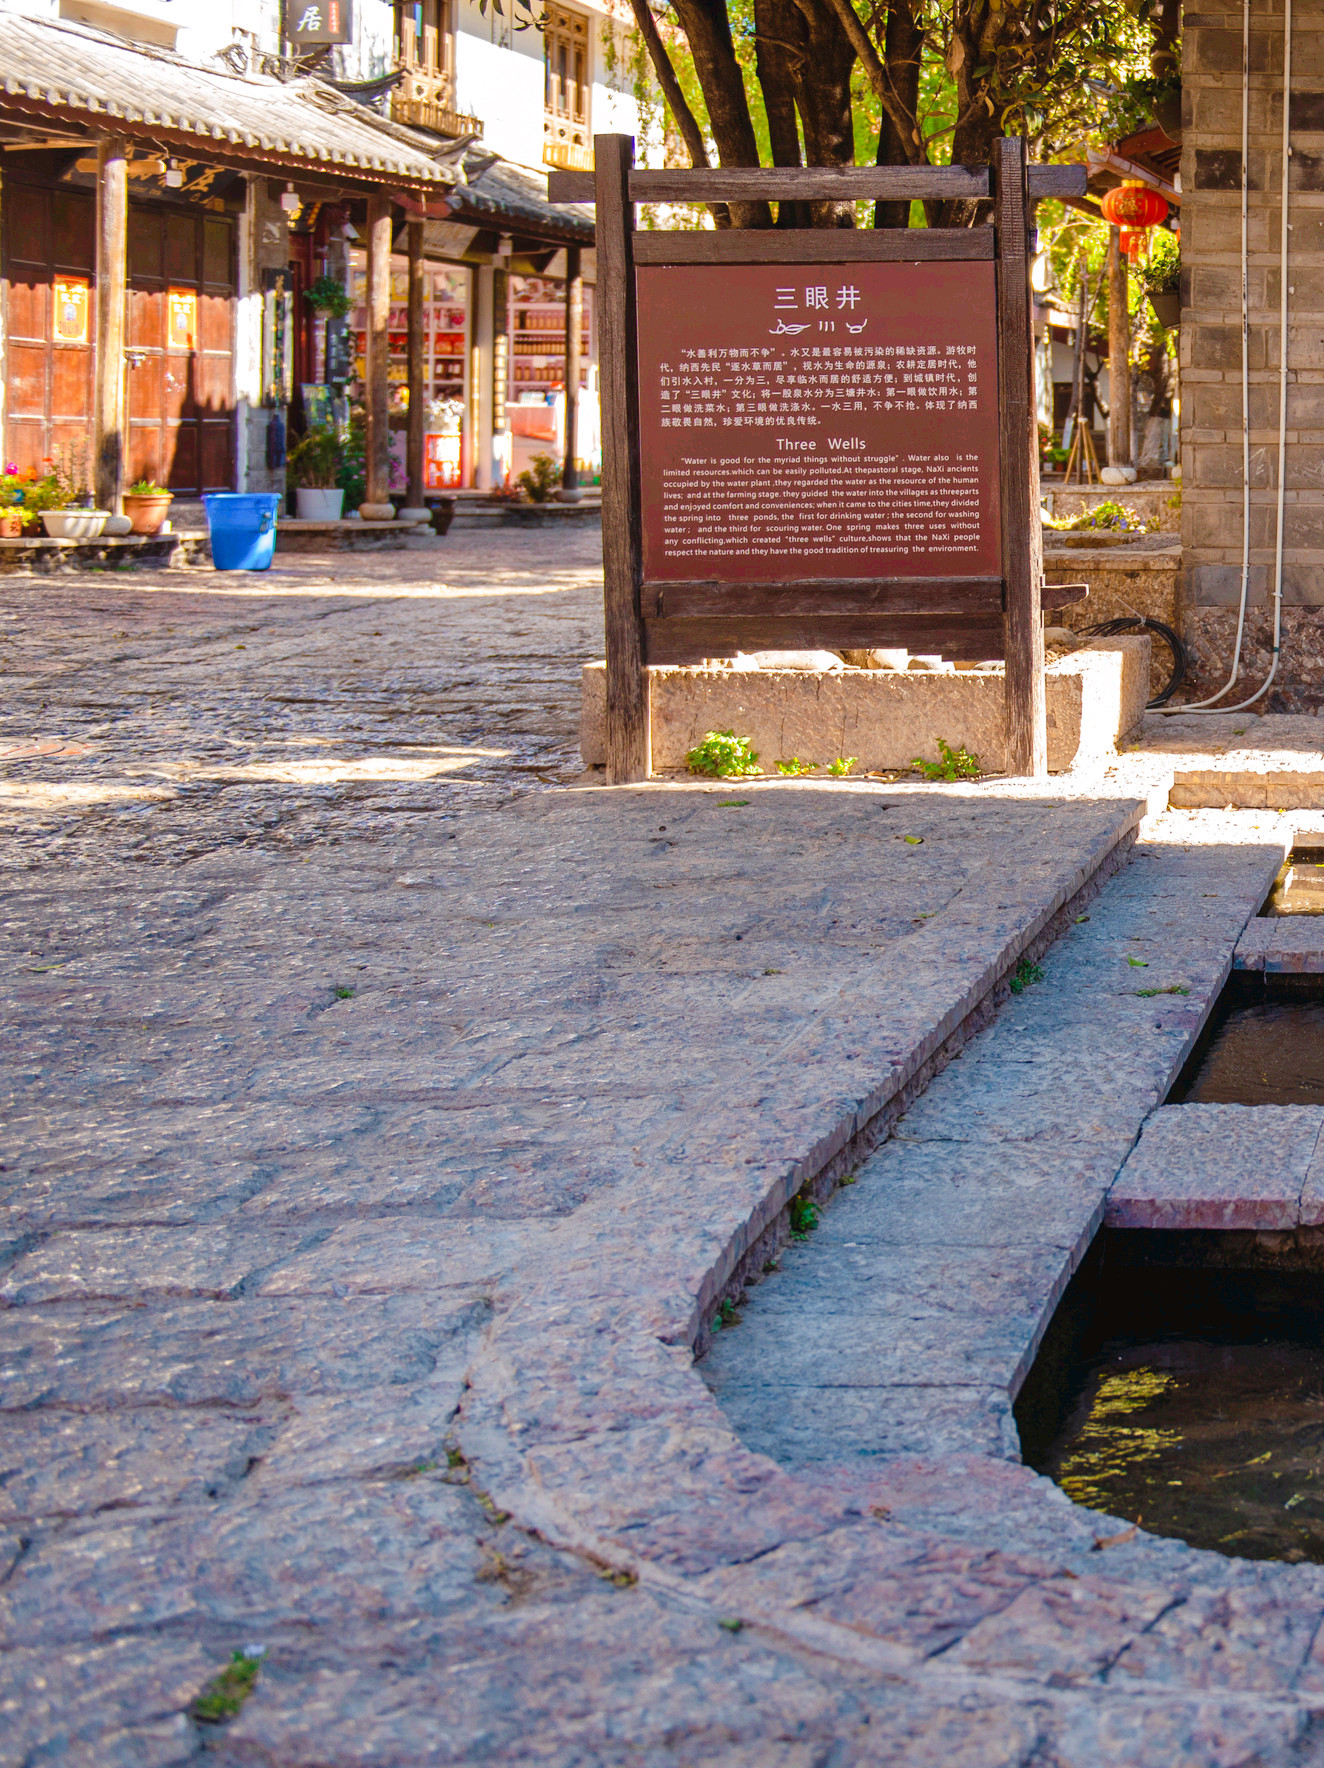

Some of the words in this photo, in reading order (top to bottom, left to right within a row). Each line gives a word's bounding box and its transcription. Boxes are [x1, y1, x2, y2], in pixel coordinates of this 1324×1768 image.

[774, 285, 861, 310] 三眼井
[776, 438, 816, 451] Three
[827, 437, 866, 450] Wells
[710, 457, 717, 465] is
[720, 457, 740, 466] good
[743, 456, 755, 464] for
[758, 456, 771, 464] the
[774, 455, 801, 465] myriad
[803, 455, 828, 465] things
[830, 455, 861, 463] without
[907, 454, 931, 462] Water
[933, 453, 950, 462] also
[956, 453, 963, 461] is
[965, 453, 978, 461] the
[772, 467, 783, 475] be
[784, 467, 807, 476] easily
[926, 465, 944, 473] NaXi
[946, 464, 979, 473] ancients
[663, 480, 699, 489] occupied
[700, 479, 710, 489] by
[712, 479, 725, 487] the
[794, 478, 828, 488] regarded
[830, 478, 844, 486] the
[878, 477, 892, 485] the
[928, 476, 936, 484] of
[938, 476, 951, 484] the
[952, 476, 979, 484] human
[686, 491, 702, 499] and
[712, 491, 725, 499] the
[726, 490, 757, 500] farming
[782, 490, 800, 499] they
[801, 490, 828, 499] guided
[831, 489, 844, 497] the
[868, 489, 884, 497] into
[885, 488, 898, 496] the
[899, 488, 929, 498] villages
[663, 503, 678, 511] and
[680, 503, 711, 512] enjoyed
[712, 502, 744, 510] comfort
[816, 501, 838, 509] when
[838, 500, 844, 508] it
[877, 500, 890, 508] the
[891, 499, 912, 508] cities
[950, 498, 980, 507] divided
[664, 514, 677, 522] the
[678, 514, 704, 524] spring
[728, 513, 749, 521] three
[781, 512, 794, 521] the
[798, 512, 814, 520] first
[816, 512, 828, 520] for
[829, 511, 862, 521] drinking
[891, 511, 904, 519] the
[906, 510, 934, 519] second
[935, 510, 947, 518] for
[948, 510, 980, 520] washing
[697, 525, 712, 533] and
[714, 525, 728, 533] the
[729, 525, 748, 533] third
[750, 524, 762, 532] for
[766, 524, 799, 534] scouring
[826, 523, 842, 531] One
[846, 523, 871, 533] spring
[875, 522, 900, 531] makes
[904, 522, 925, 530] three
[950, 521, 980, 529] without
[664, 538, 679, 547] any
[752, 535, 781, 544] created
[895, 534, 911, 542] that
[915, 533, 928, 541] the
[932, 533, 950, 541] NaXi
[954, 533, 980, 542] people
[664, 549, 694, 558] respect
[694, 548, 708, 556] the
[708, 548, 734, 556] nature
[735, 547, 750, 555] and
[751, 547, 769, 557] they
[770, 547, 788, 555] have
[789, 547, 802, 555] the
[803, 546, 824, 556] good
[825, 546, 859, 554] tradition
[860, 545, 869, 554] of
[869, 545, 909, 555] treasuring
[912, 545, 925, 553] the
